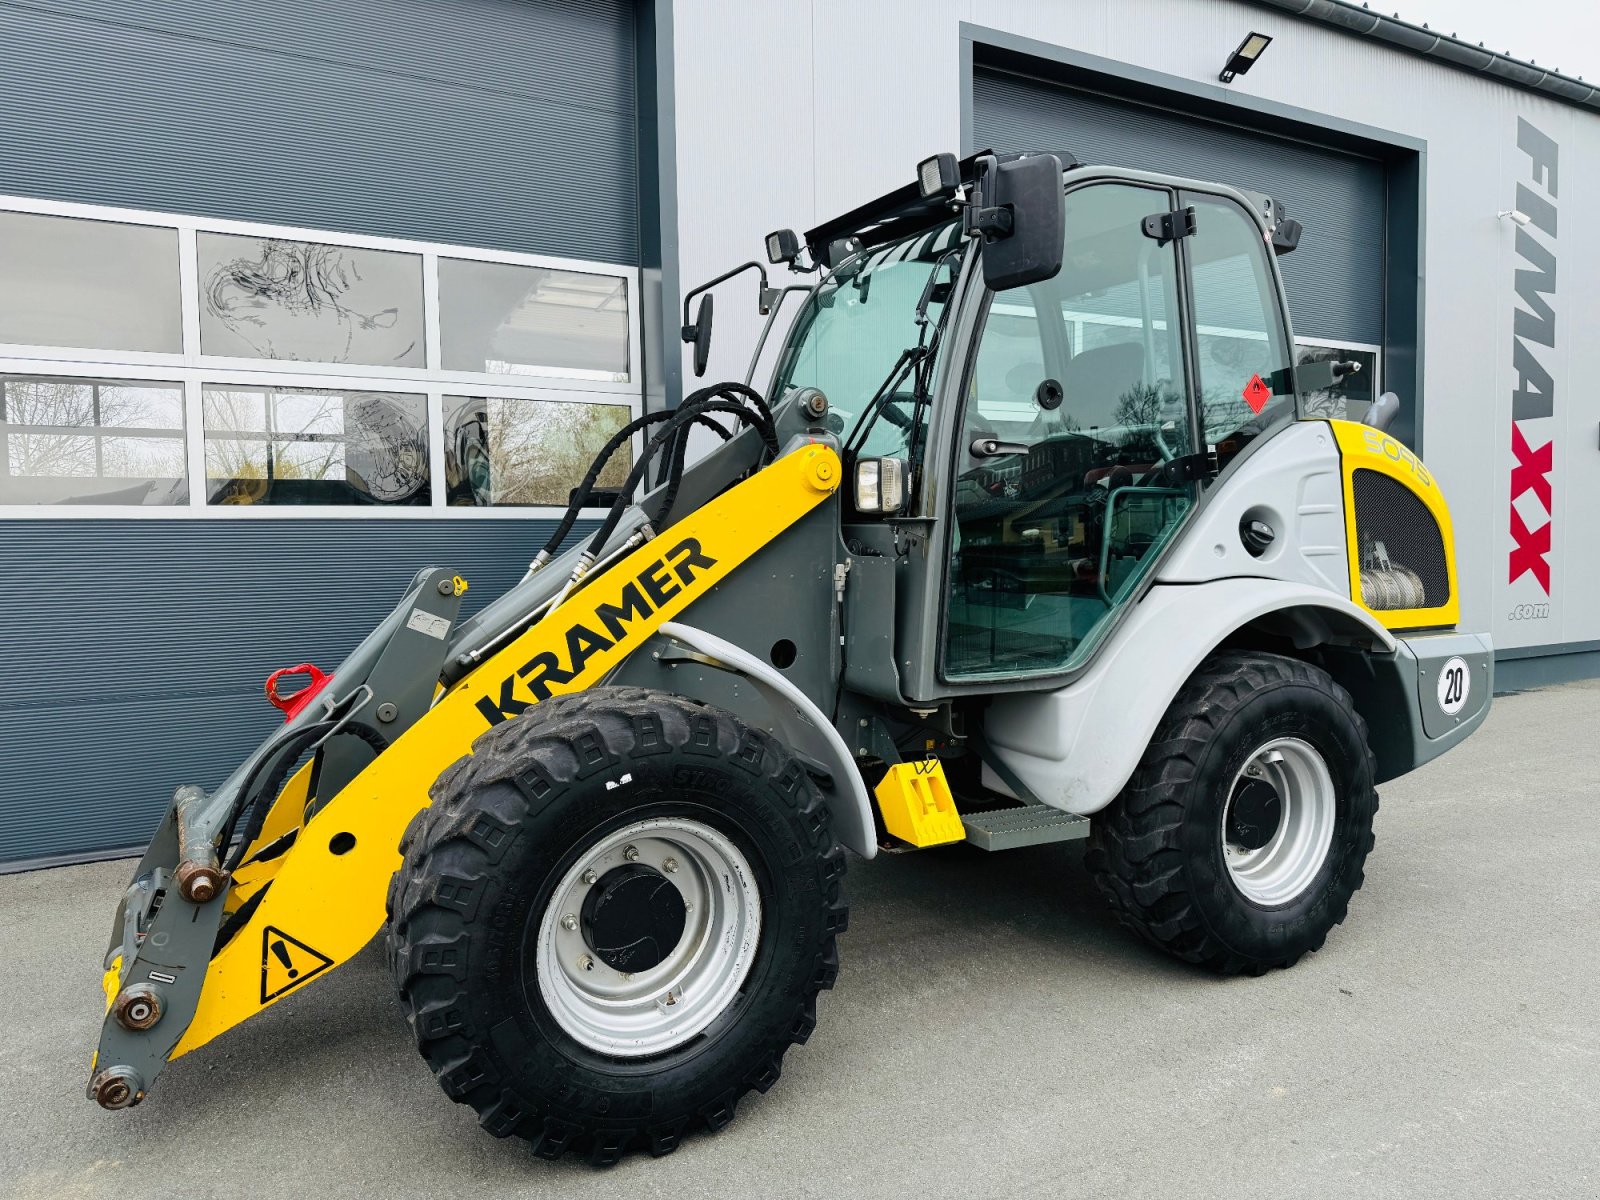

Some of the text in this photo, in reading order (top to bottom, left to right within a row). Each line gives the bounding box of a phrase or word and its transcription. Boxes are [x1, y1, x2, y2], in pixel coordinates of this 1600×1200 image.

[1508, 115, 1559, 597] FIMAXX
[1362, 430, 1431, 487] 5095
[475, 537, 718, 727] KRAMER
[1508, 603, 1550, 620] .com
[1445, 667, 1463, 704] 20
